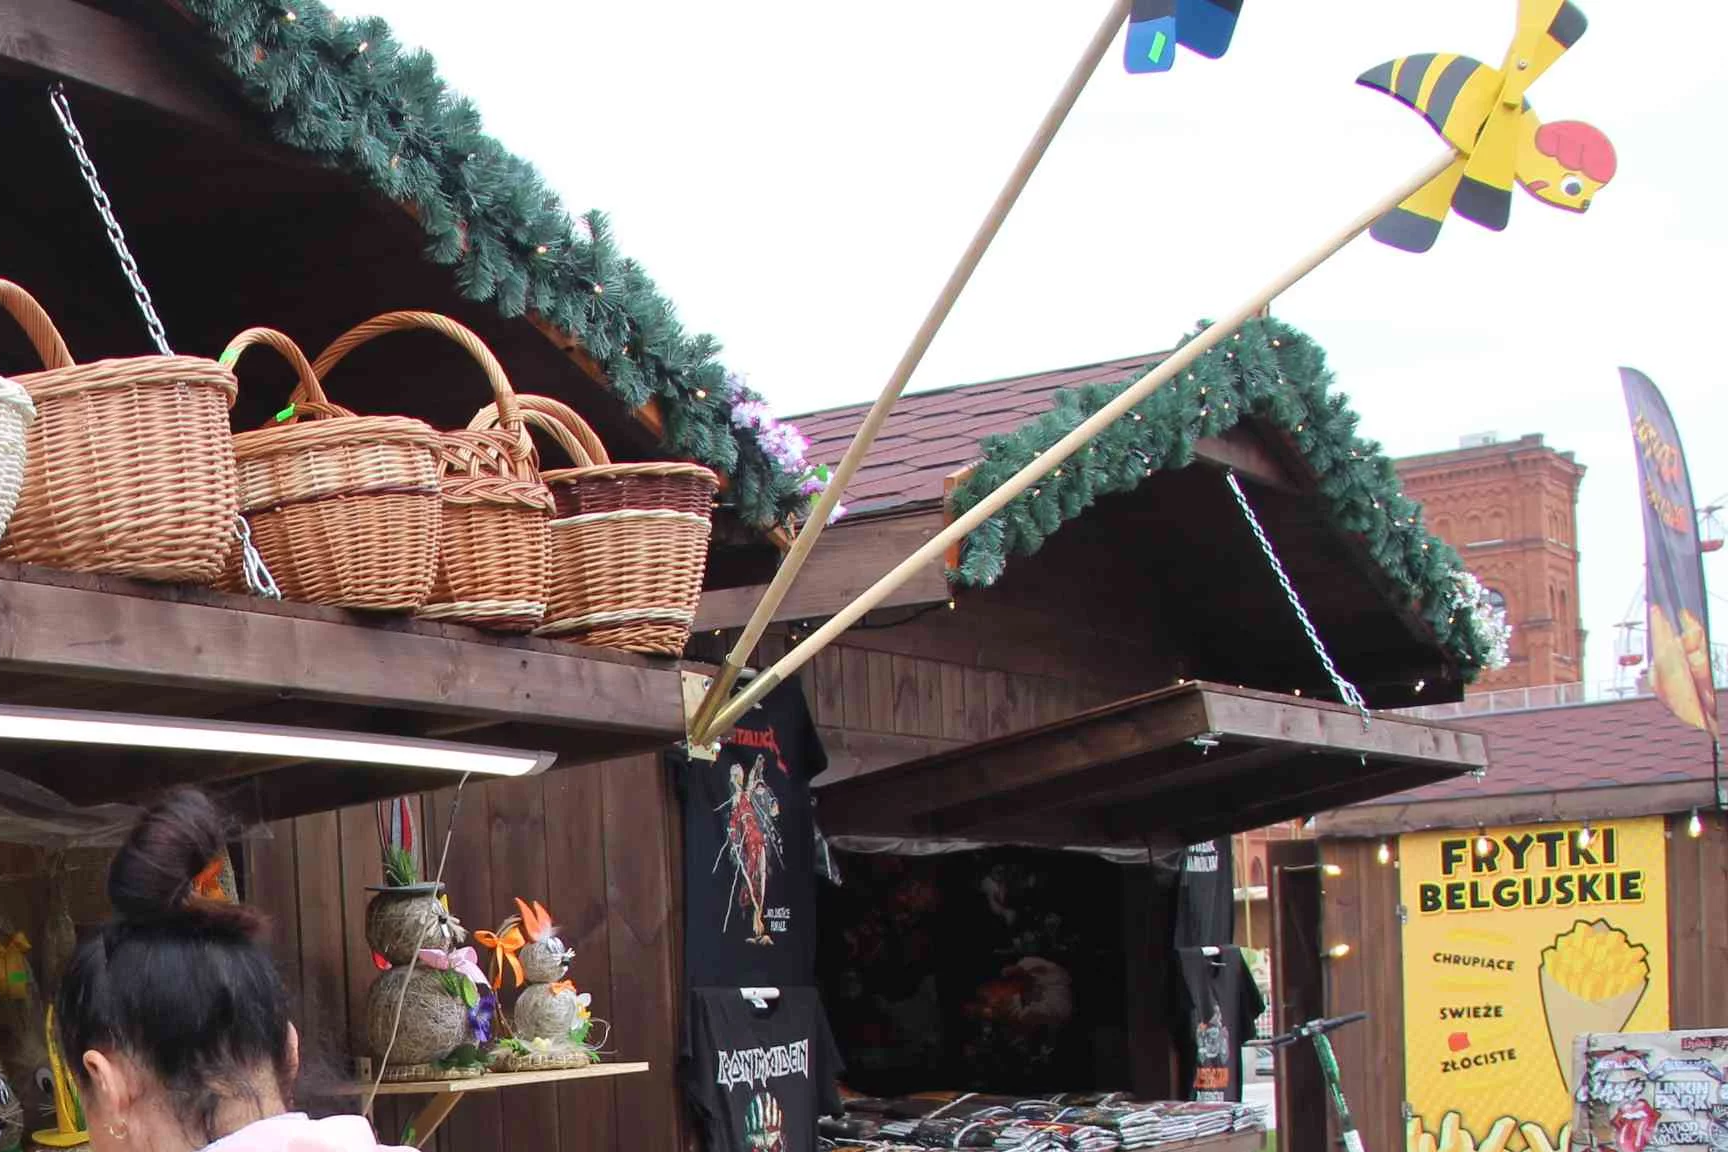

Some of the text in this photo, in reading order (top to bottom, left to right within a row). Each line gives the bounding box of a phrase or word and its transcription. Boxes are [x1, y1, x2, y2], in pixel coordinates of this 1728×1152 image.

[1441, 828, 1615, 875] FRYTKI
[1419, 870, 1642, 913] BELGIJSKIE
[1441, 1048, 1517, 1073] ZŁOCISTE
[1655, 1081, 1708, 1095] LINKIN
